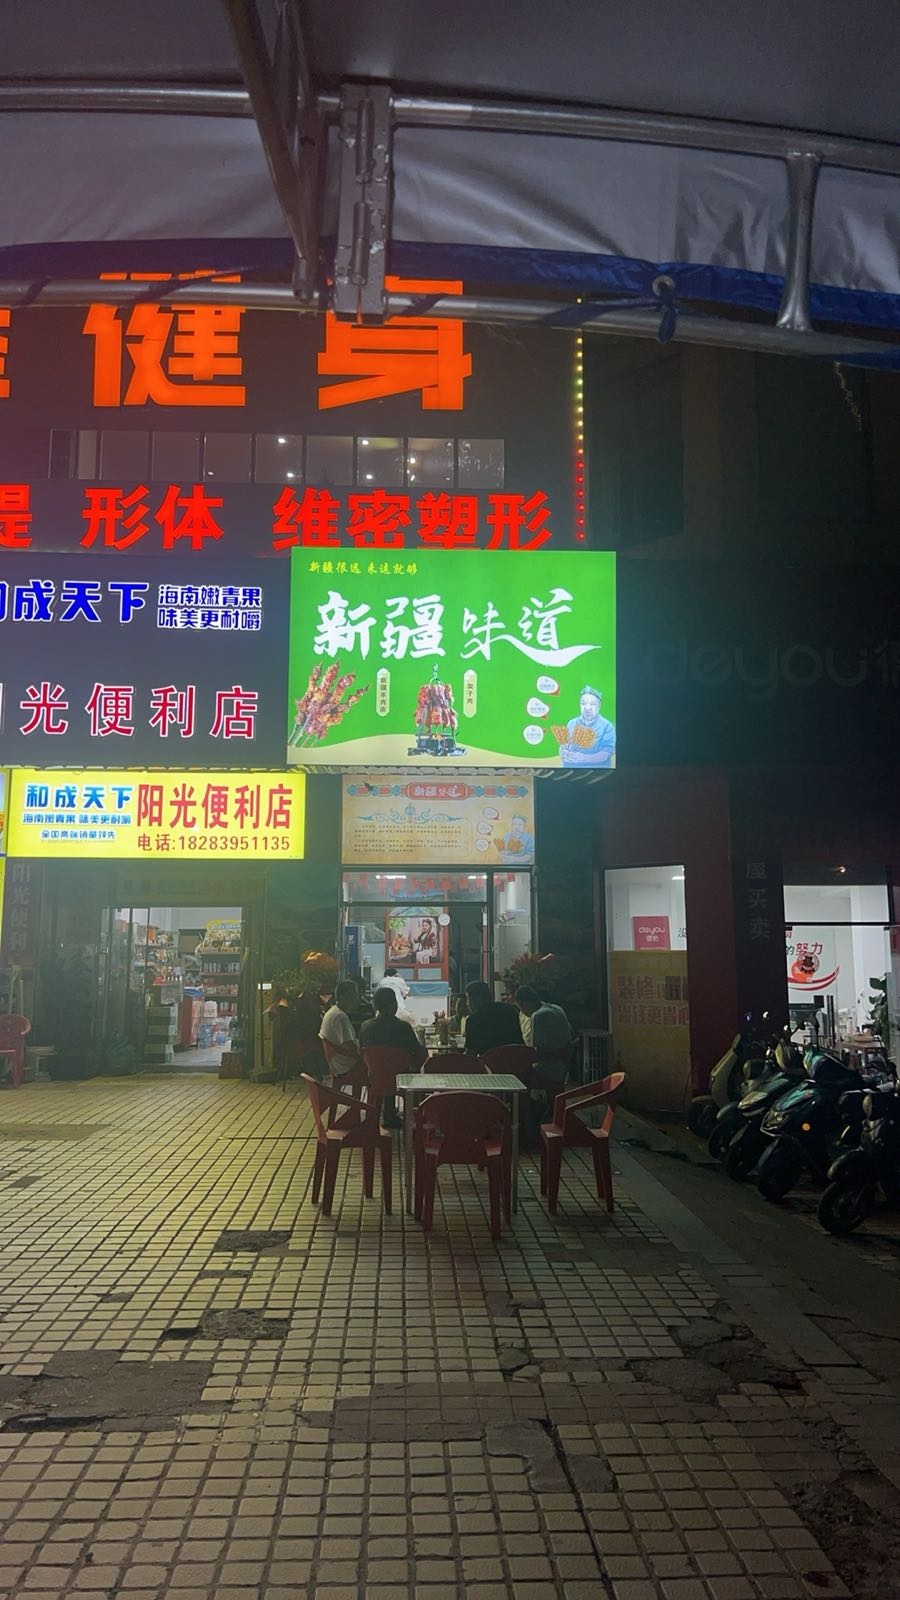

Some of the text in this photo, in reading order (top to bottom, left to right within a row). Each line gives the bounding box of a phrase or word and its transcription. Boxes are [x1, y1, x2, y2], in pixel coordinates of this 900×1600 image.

[80, 484, 224, 550] 形体
[272, 487, 553, 551] 维密塑形
[0, 579, 149, 624] 成天下
[157, 584, 262, 607] 海南嫩青果
[157, 608, 262, 631] 味美更耐嚼
[313, 587, 603, 667] 新疆味道
[0, 681, 259, 740] 光便利店
[26, 783, 294, 830] 和成天下 阳光便利店
[137, 833, 291, 852] 电话:18283951135
